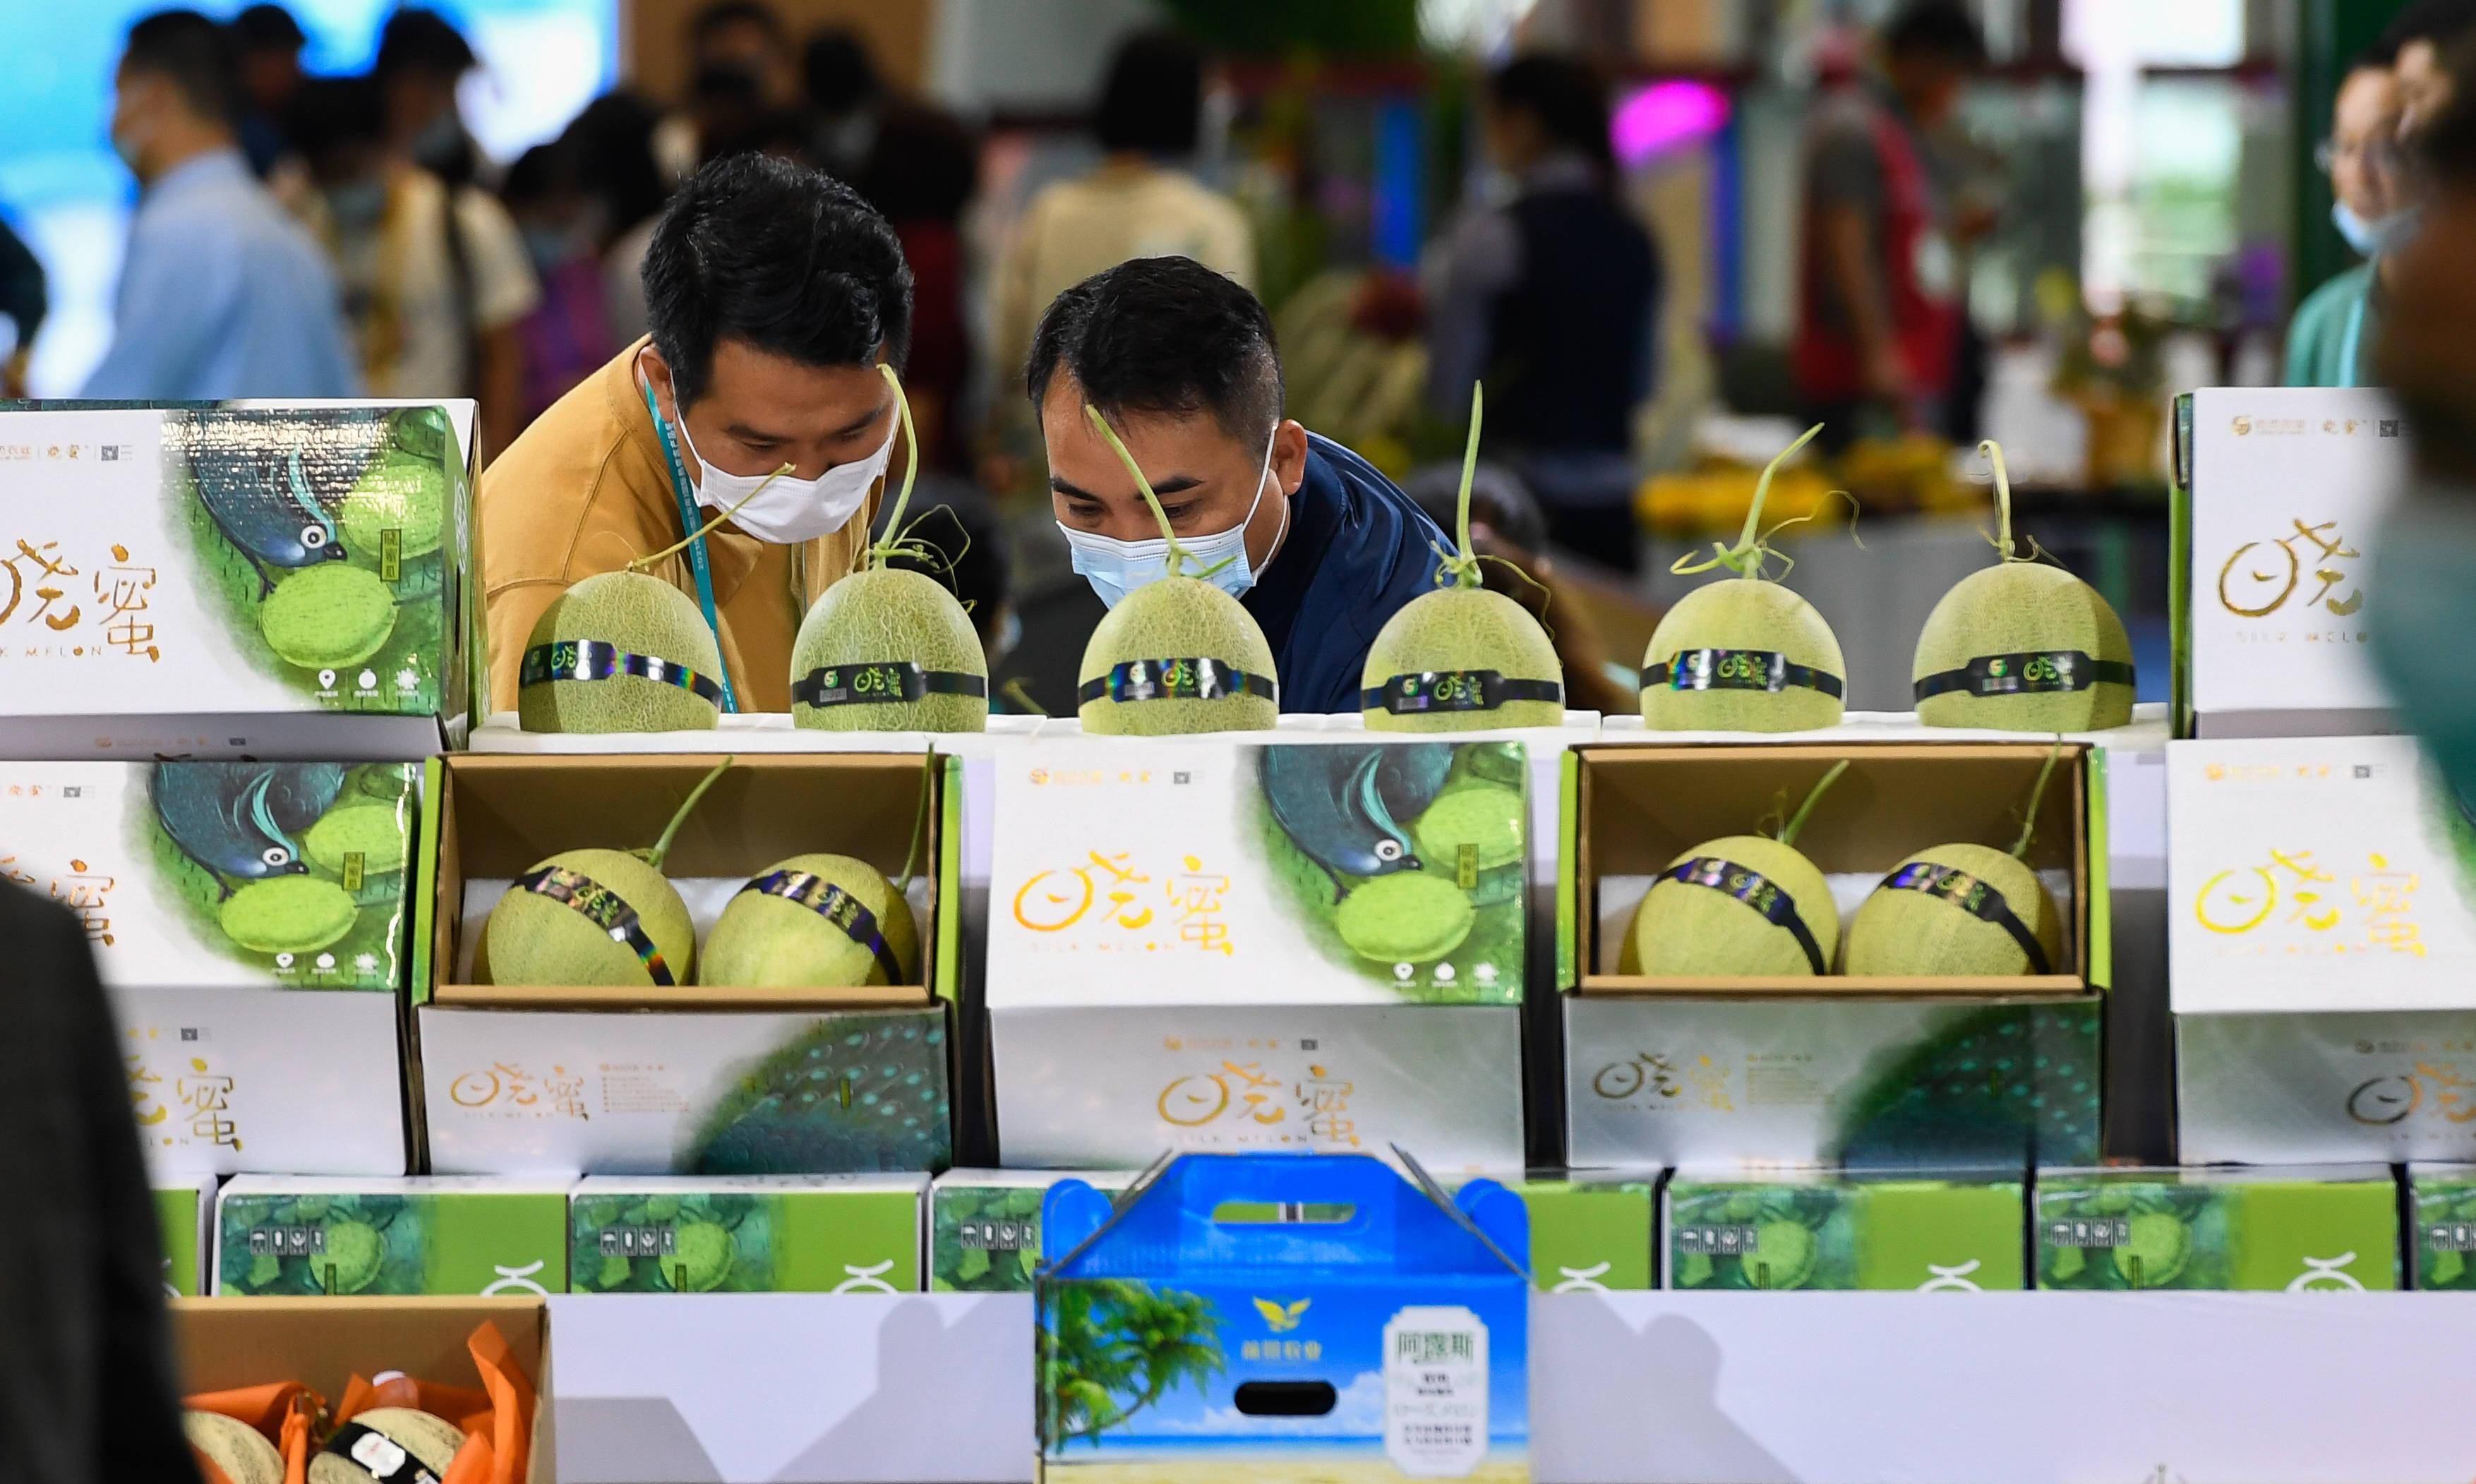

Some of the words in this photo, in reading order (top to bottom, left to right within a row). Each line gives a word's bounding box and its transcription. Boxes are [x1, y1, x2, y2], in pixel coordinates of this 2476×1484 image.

[1013, 849, 1234, 957] 晓蜜
[2195, 848, 2427, 958] 晓蜜
[1158, 1061, 1361, 1147] 晓蜜
